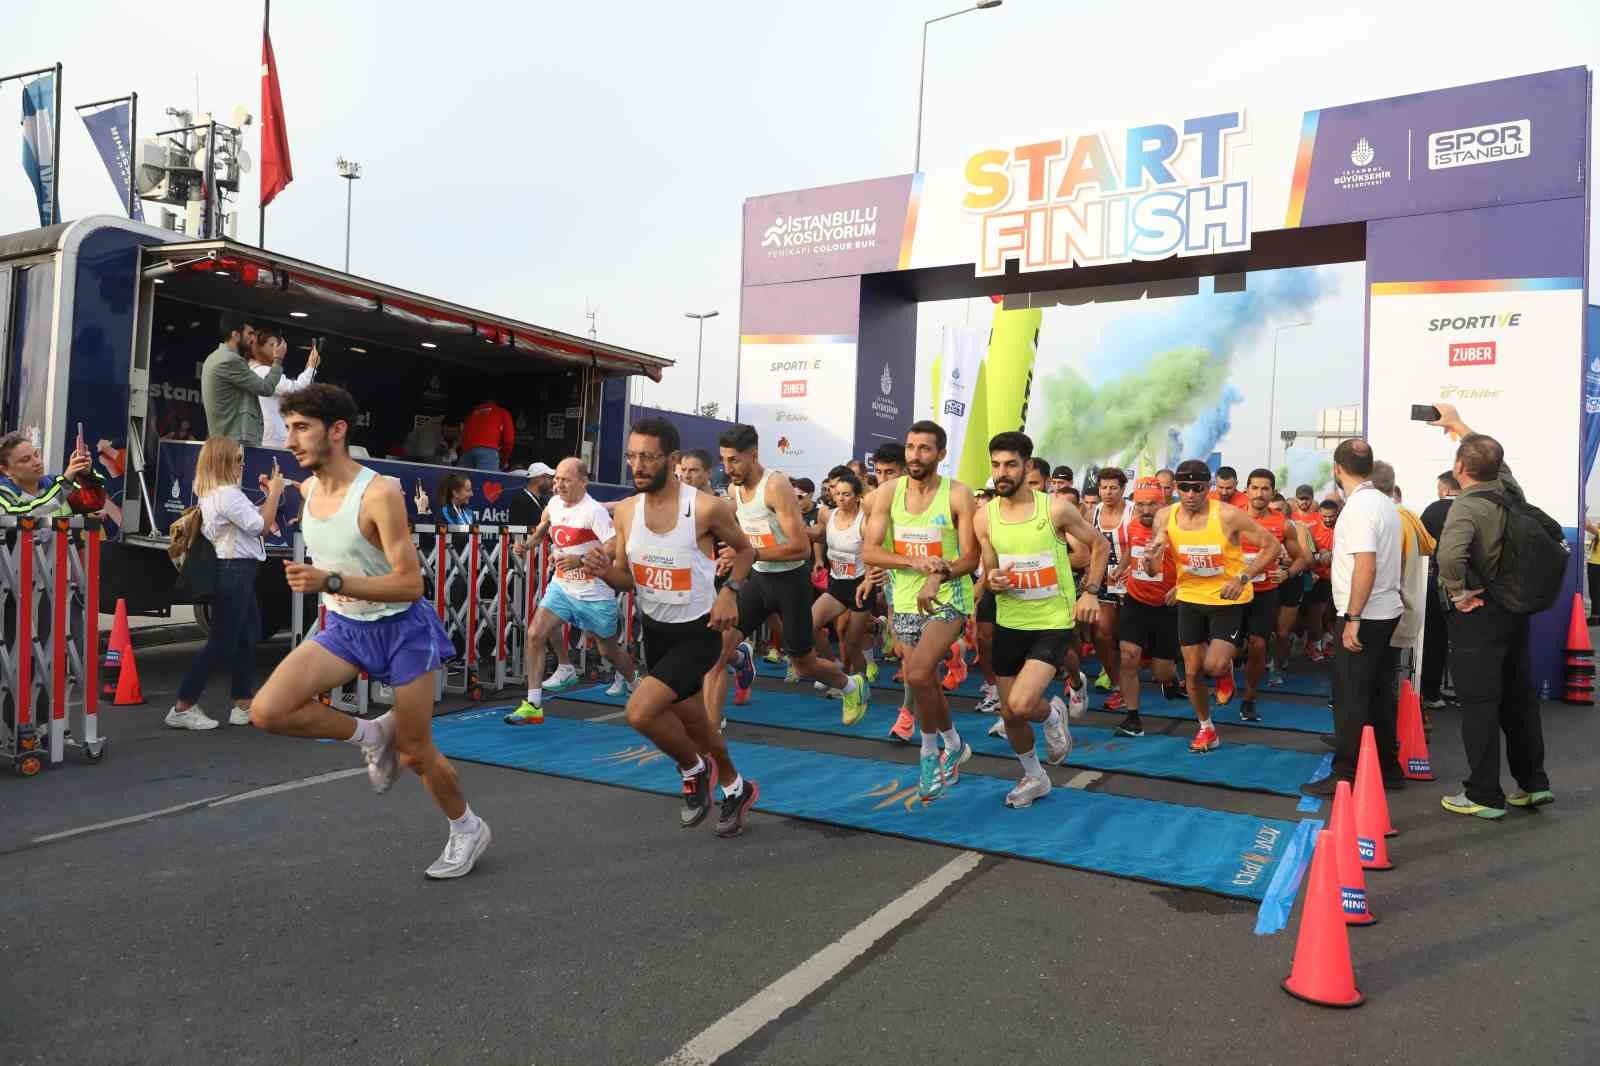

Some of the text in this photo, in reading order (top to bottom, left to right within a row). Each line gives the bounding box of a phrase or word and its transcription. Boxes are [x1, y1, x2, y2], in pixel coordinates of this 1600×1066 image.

[1435, 125, 1523, 153] SPOR
[961, 111, 1240, 210] START
[981, 181, 1249, 273] FINISH
[1428, 313, 1522, 331] SPORTIVE
[645, 567, 673, 591] 246
[1015, 571, 1040, 588] 711
